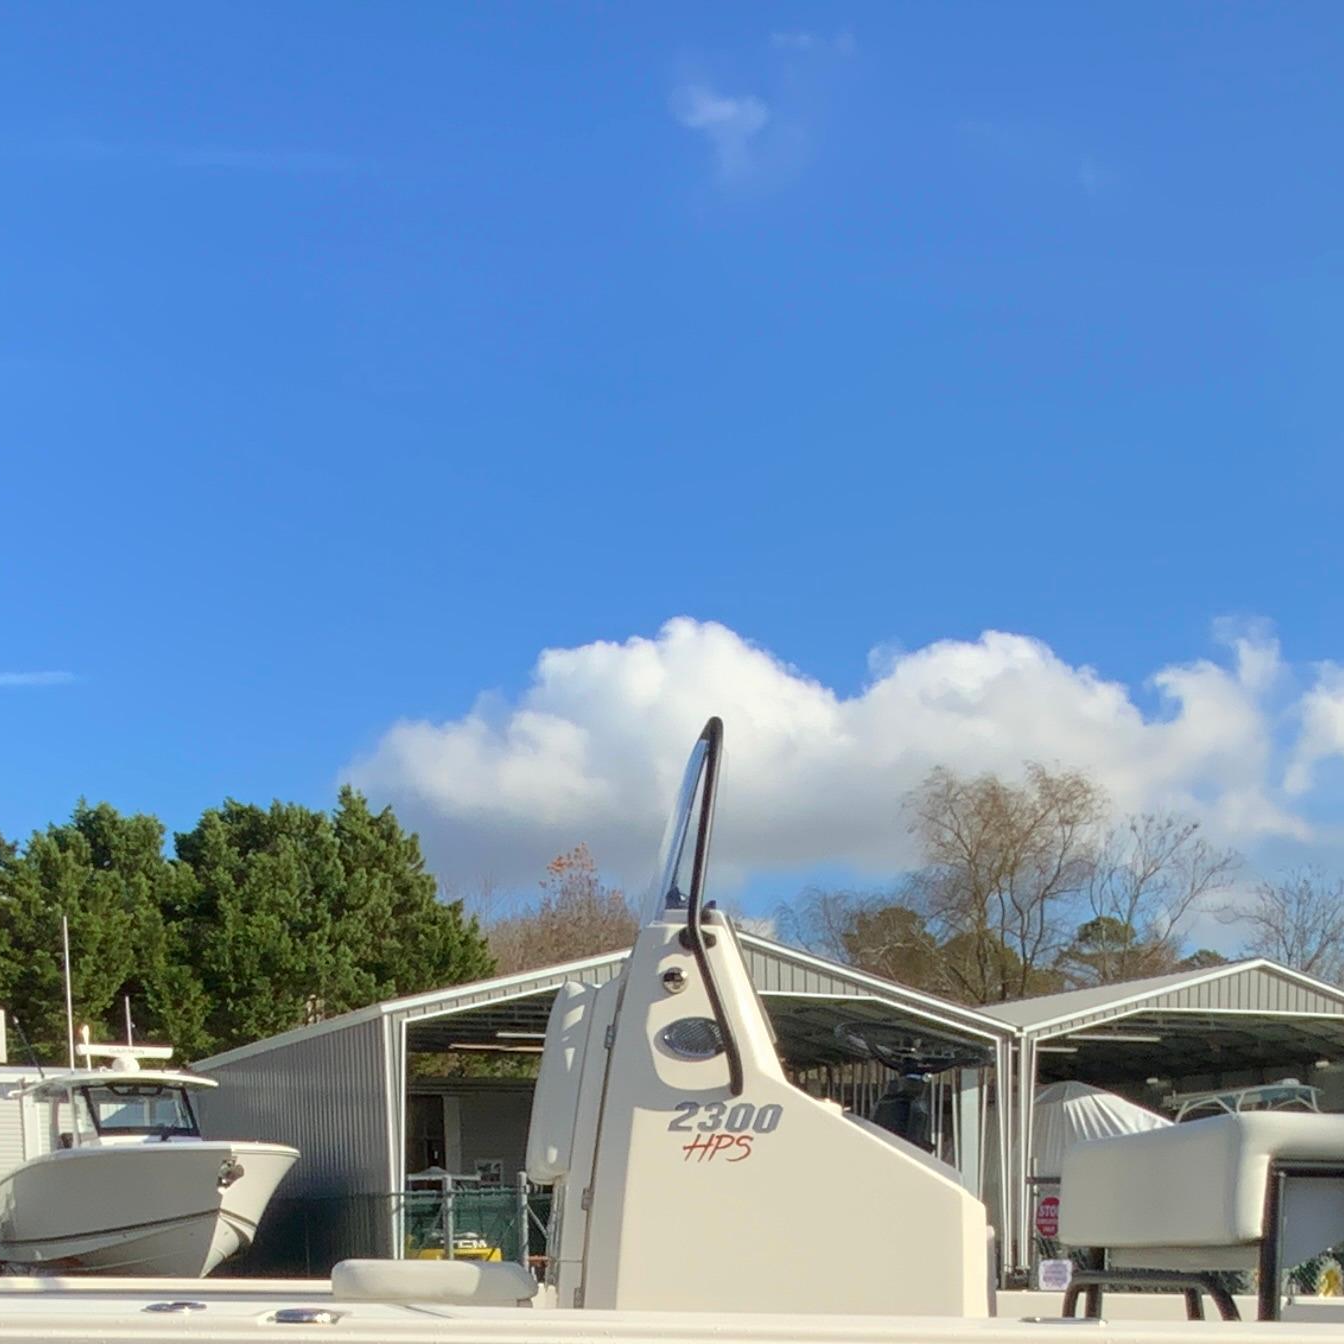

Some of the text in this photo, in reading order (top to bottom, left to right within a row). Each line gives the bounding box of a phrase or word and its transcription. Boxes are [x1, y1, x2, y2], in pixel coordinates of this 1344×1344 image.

[667, 1101, 784, 1134] 2300
[682, 1133, 754, 1163] HPS
[1039, 1204, 1058, 1217] STO
